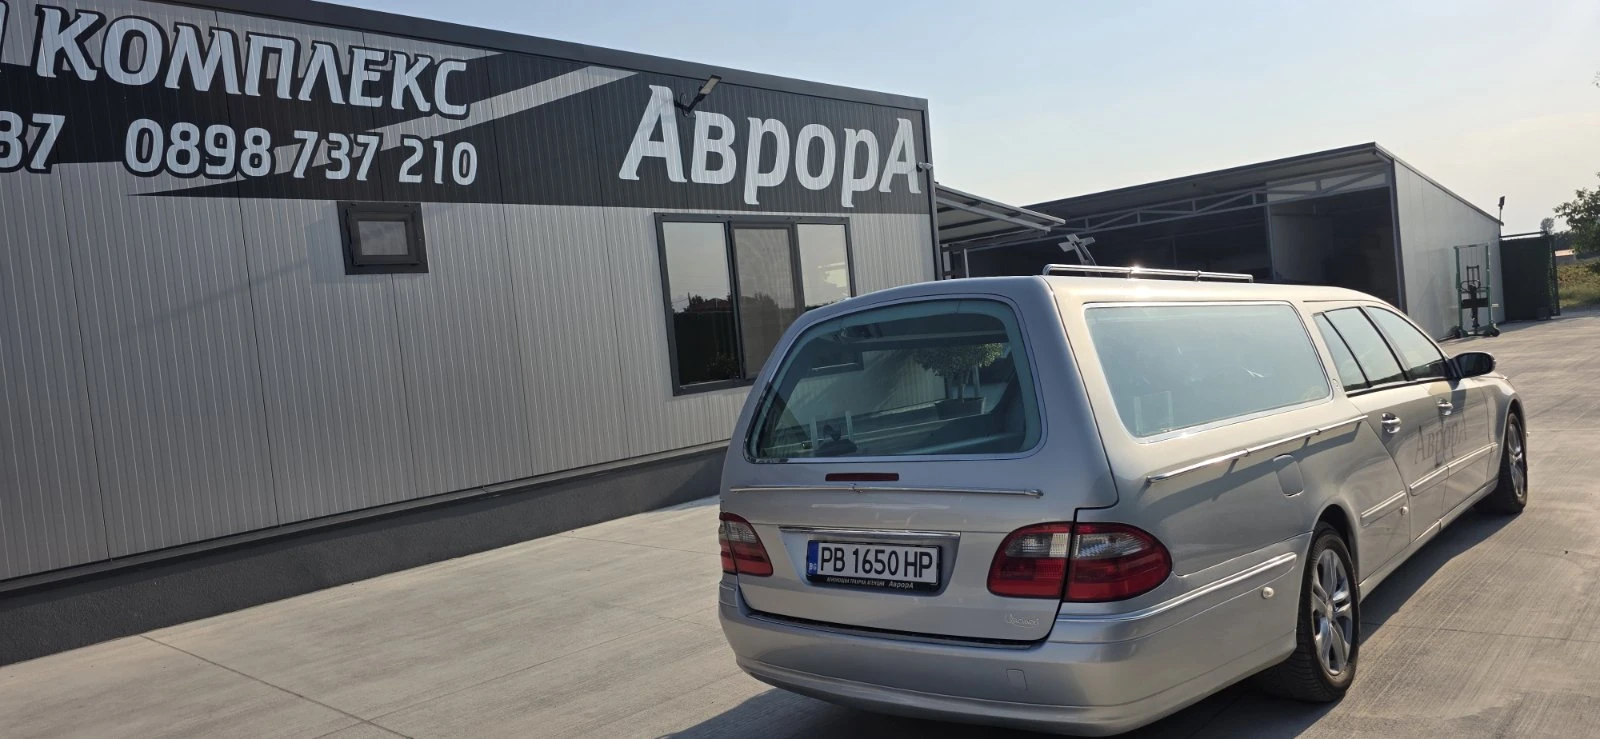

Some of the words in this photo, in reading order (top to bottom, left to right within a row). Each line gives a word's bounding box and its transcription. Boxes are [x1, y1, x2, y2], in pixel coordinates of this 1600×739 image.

[36, 7, 468, 116] КОМПЛЕКС
[125, 118, 272, 177] 0898
[293, 130, 381, 182] 737
[399, 139, 478, 186] 210
[852, 548, 899, 576] 1650
